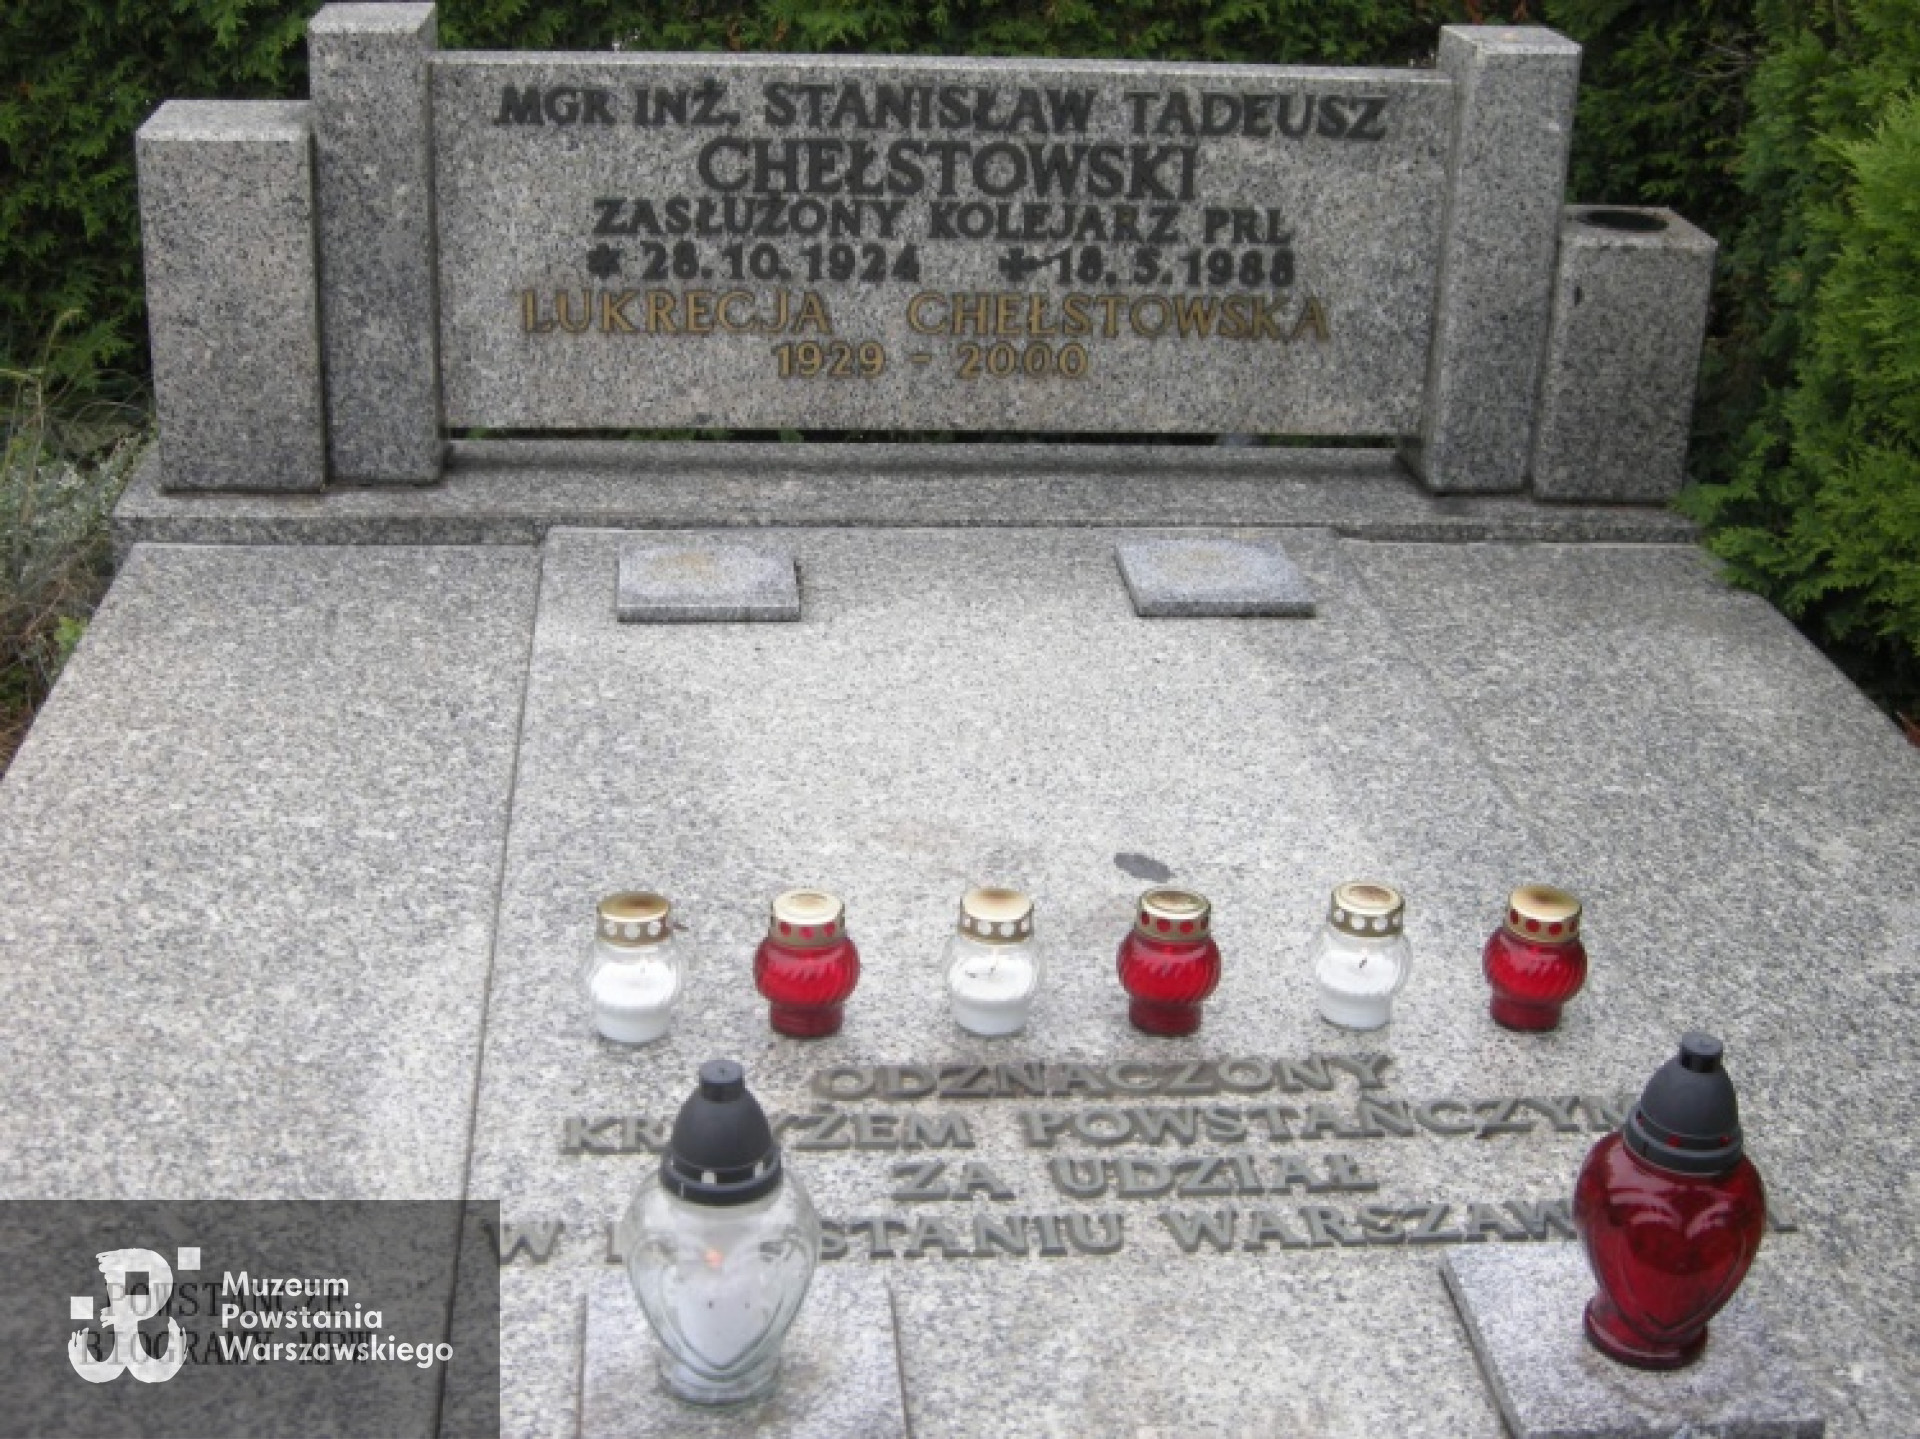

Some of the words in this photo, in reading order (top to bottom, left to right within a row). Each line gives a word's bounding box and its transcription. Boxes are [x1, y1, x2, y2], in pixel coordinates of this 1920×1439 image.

[494, 85, 616, 126] MGR
[763, 80, 1099, 133] STANISŁAW
[1123, 90, 1389, 141] TADEUSZ
[699, 136, 1199, 200] CHEŁSTOWSKI
[593, 193, 906, 238] ZASŁUŻONY
[929, 200, 1181, 243] KOLEJARZ
[1203, 207, 1295, 245] PRL
[517, 287, 833, 336] LUKRECJA
[906, 290, 1332, 343] CHEŁSTOWSKA
[773, 340, 887, 380] 1929
[956, 342, 1090, 381] 2000
[811, 1052, 1397, 1100] ODZNACZONY
[562, 1102, 977, 1154] KRŻEM
[890, 1160, 1016, 1202] ZA
[1048, 1150, 1378, 1198] UDZIAŁ
[483, 1215, 566, 1266] W
